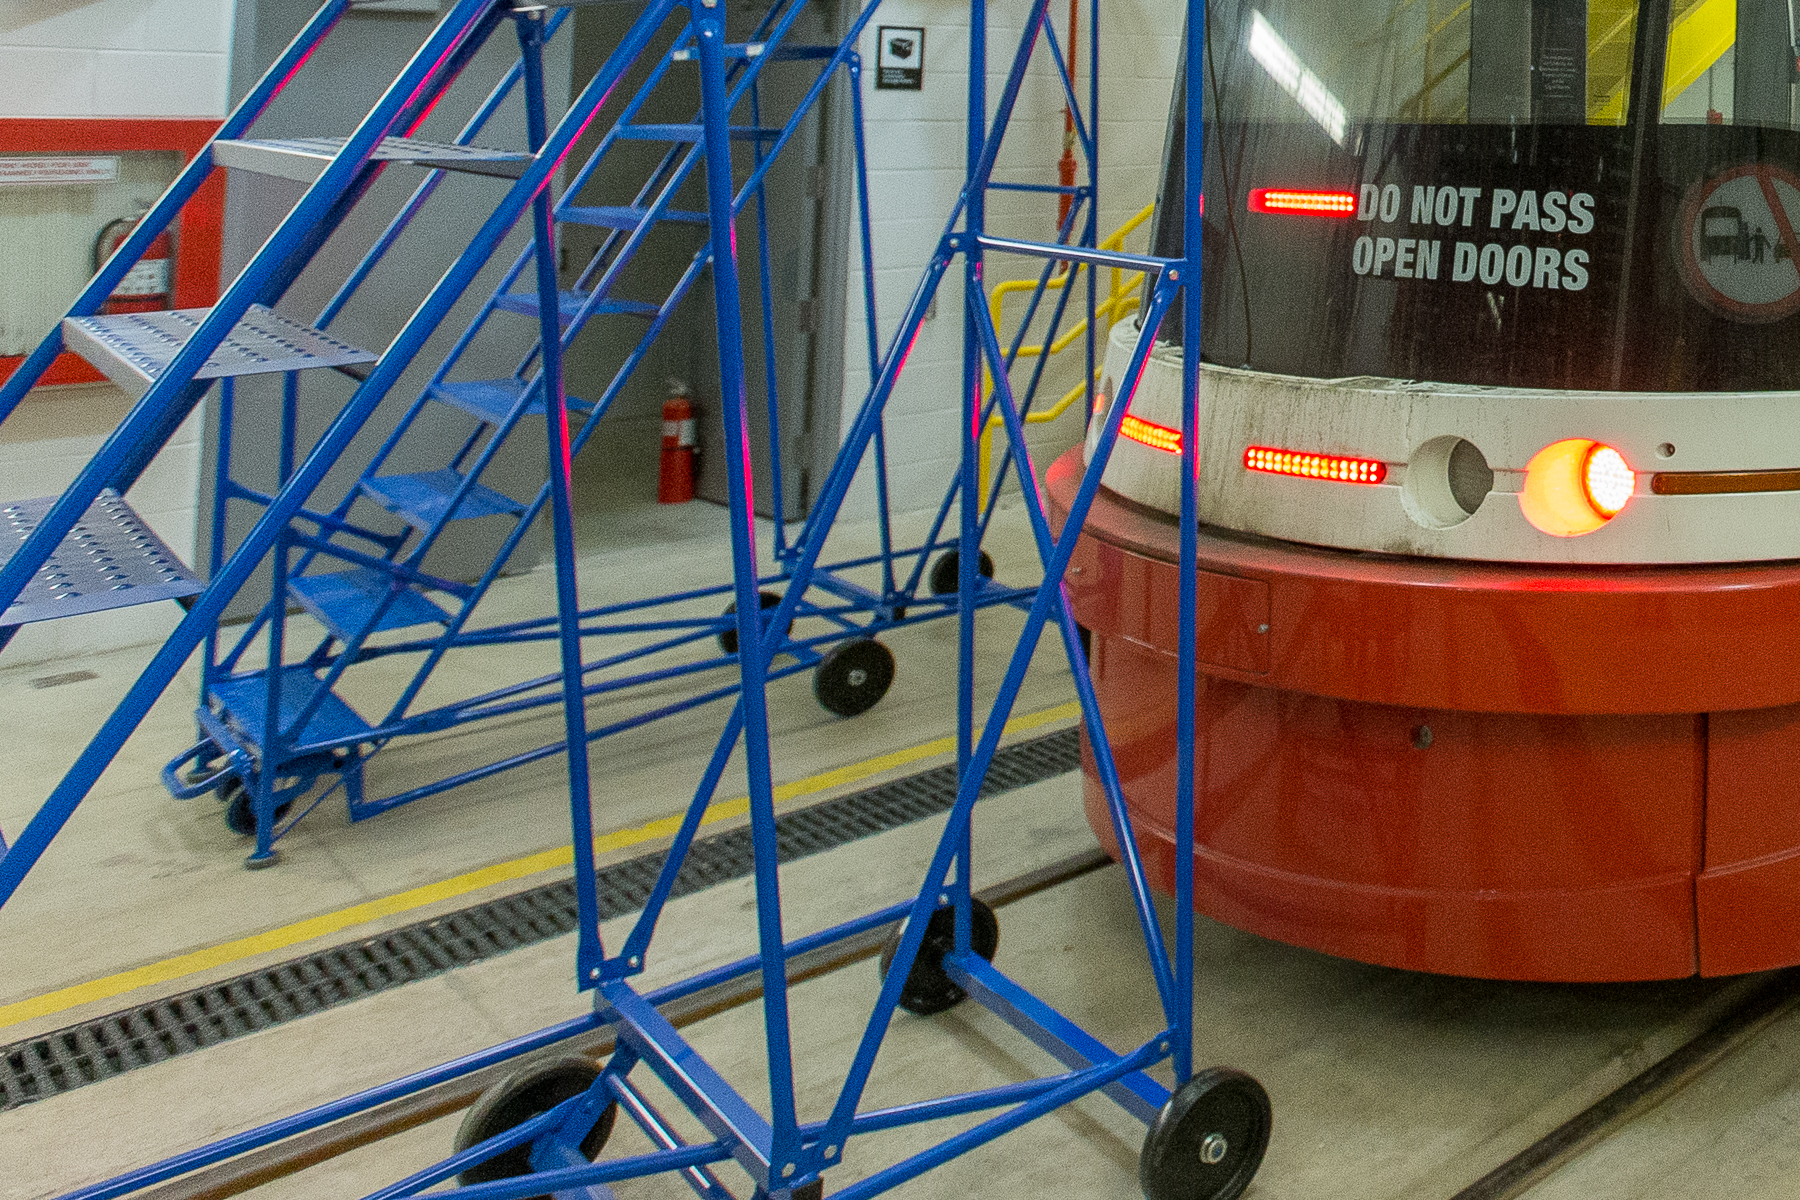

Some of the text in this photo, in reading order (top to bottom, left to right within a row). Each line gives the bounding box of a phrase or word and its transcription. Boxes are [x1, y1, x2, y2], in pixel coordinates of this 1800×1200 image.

[1356, 183, 1595, 234] DO NOT PASS
[1352, 236, 1590, 291] OPEN DOORS
